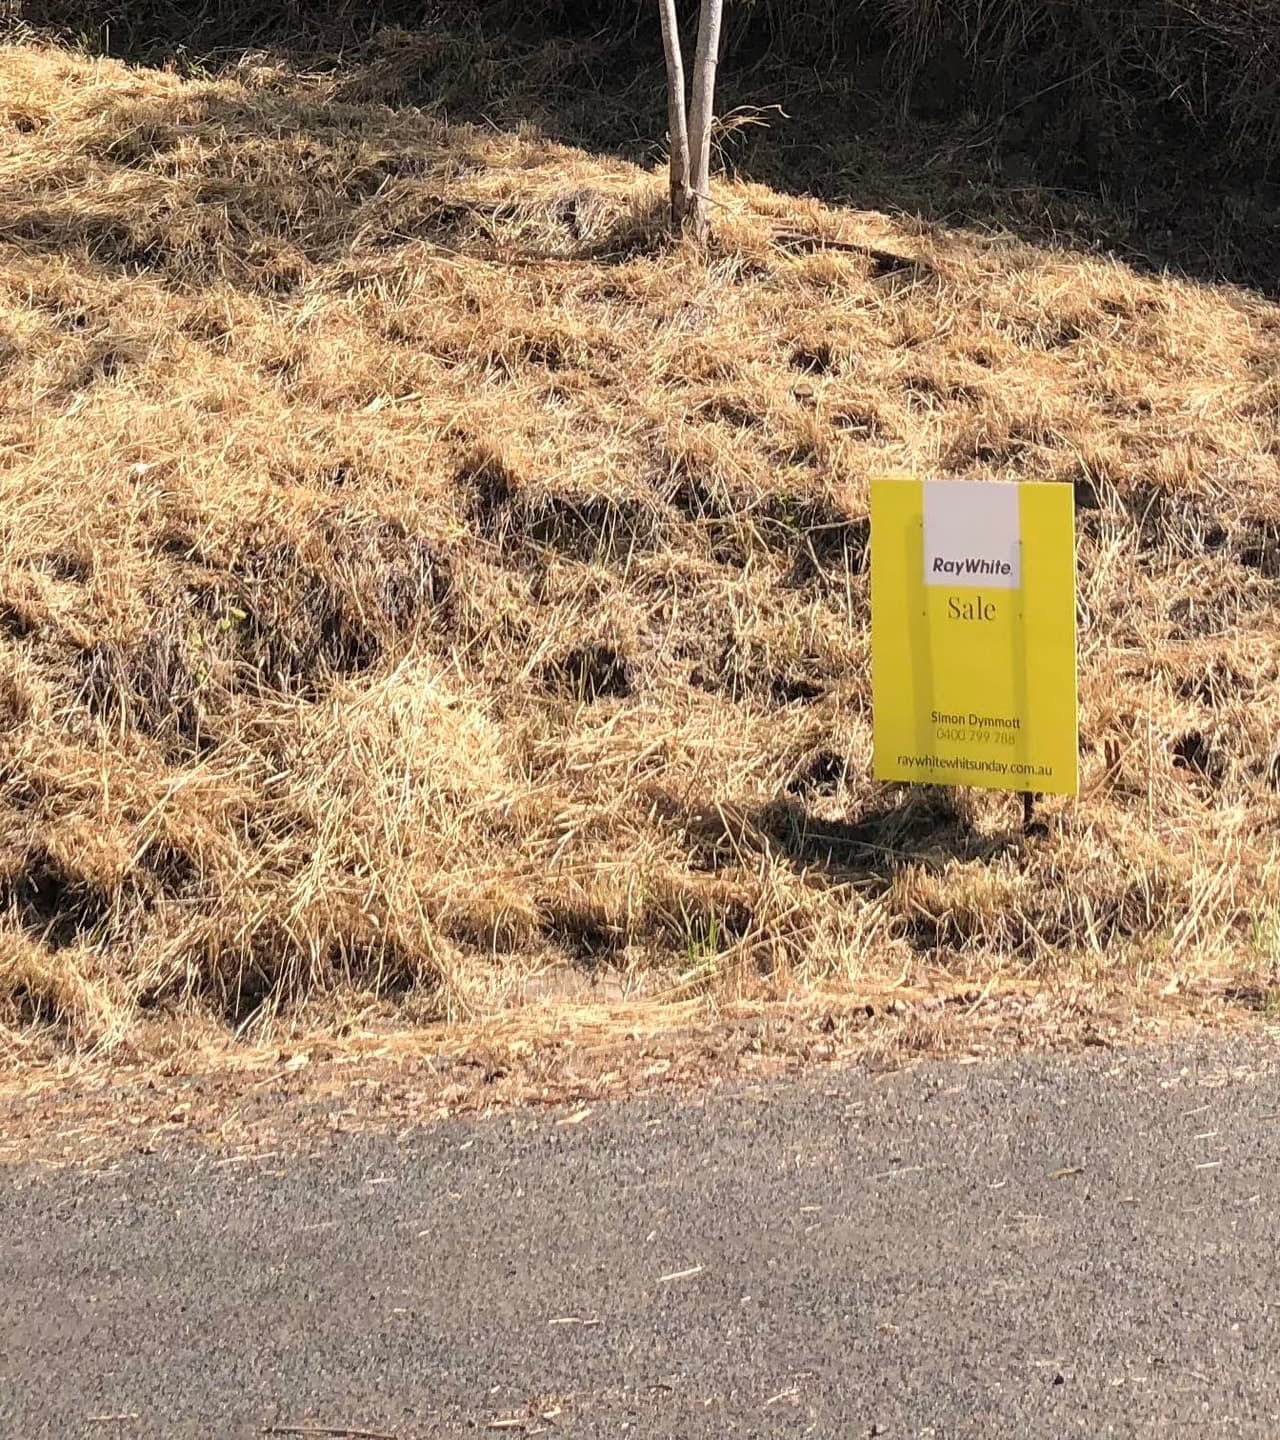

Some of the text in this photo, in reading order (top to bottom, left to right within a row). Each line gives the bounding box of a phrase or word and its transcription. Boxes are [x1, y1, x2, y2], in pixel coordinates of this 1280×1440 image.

[947, 596, 997, 621] Sale
[931, 711, 966, 725] Simon
[936, 727, 966, 742] 0400
[897, 754, 1053, 776] raywhitewhitsunday.com.au
